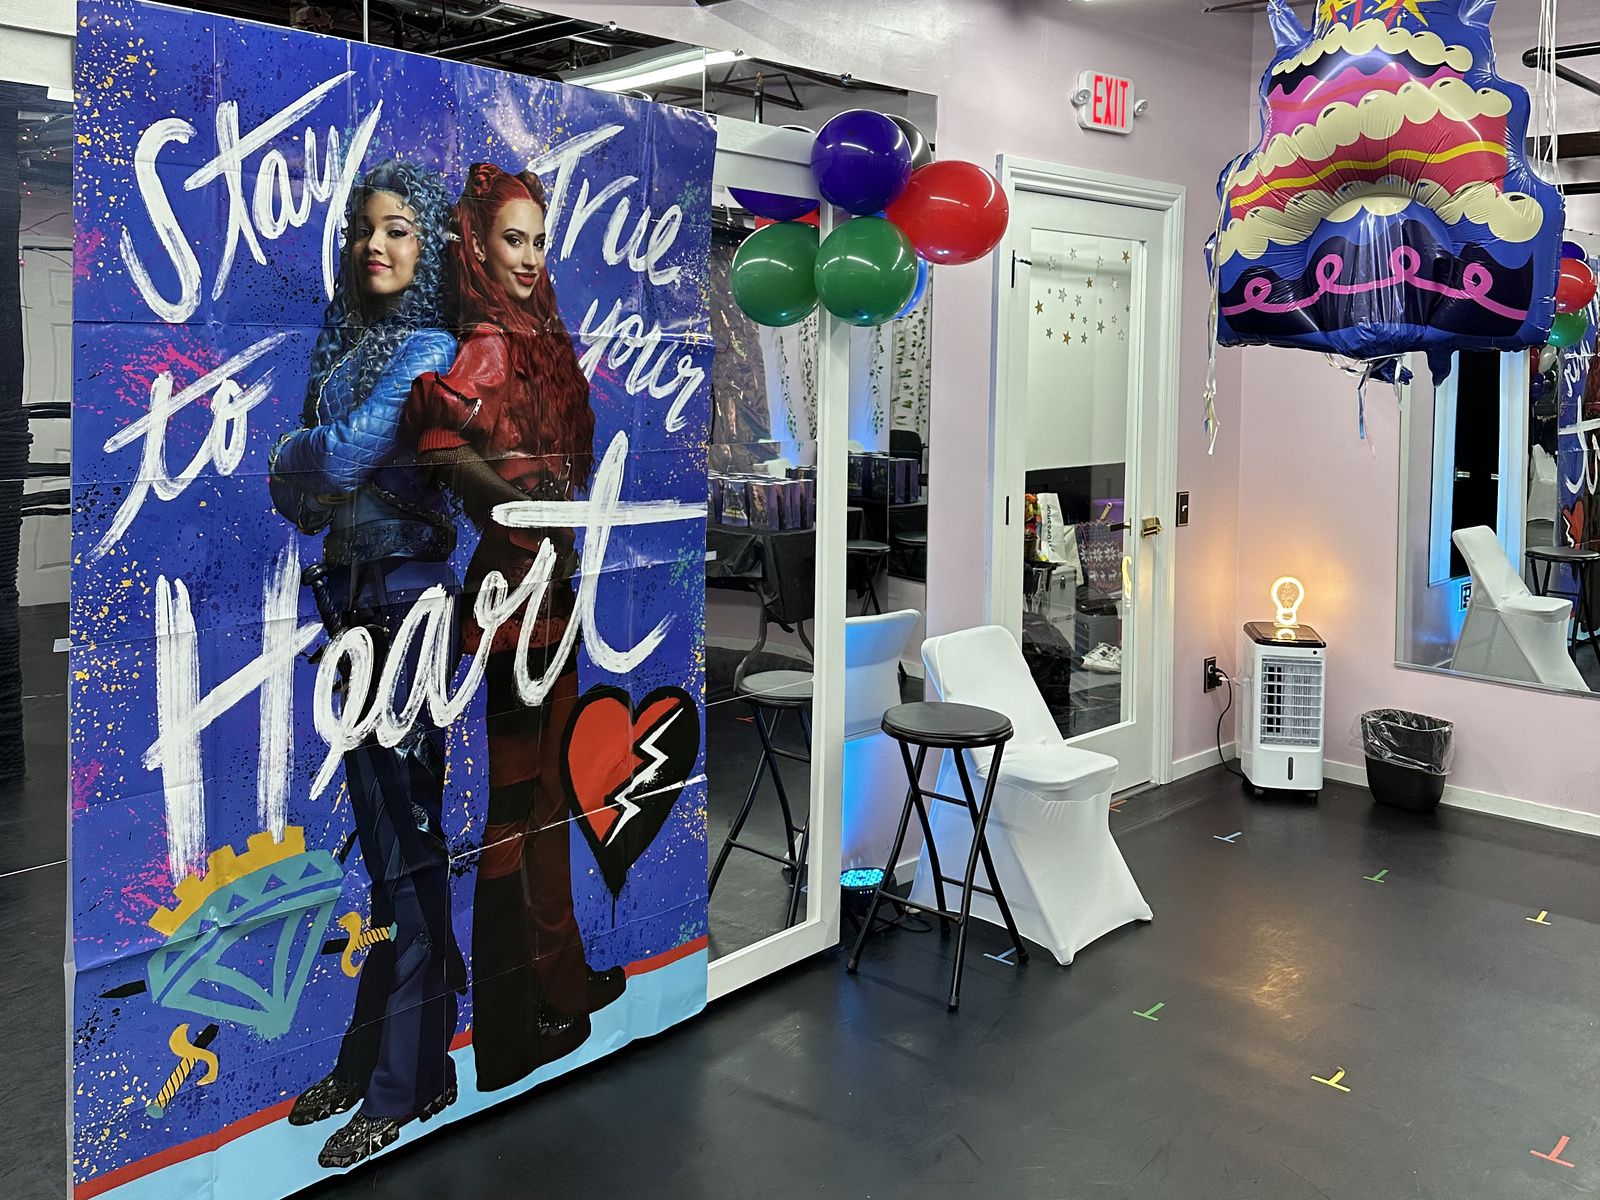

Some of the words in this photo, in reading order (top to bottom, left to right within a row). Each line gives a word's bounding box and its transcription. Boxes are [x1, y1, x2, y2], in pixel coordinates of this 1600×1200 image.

[120, 70, 383, 323] Stay
[527, 124, 683, 285] True
[1092, 74, 1129, 128] EXIT
[87, 333, 286, 561] to
[578, 298, 705, 432] your
[142, 430, 707, 887] Heart
